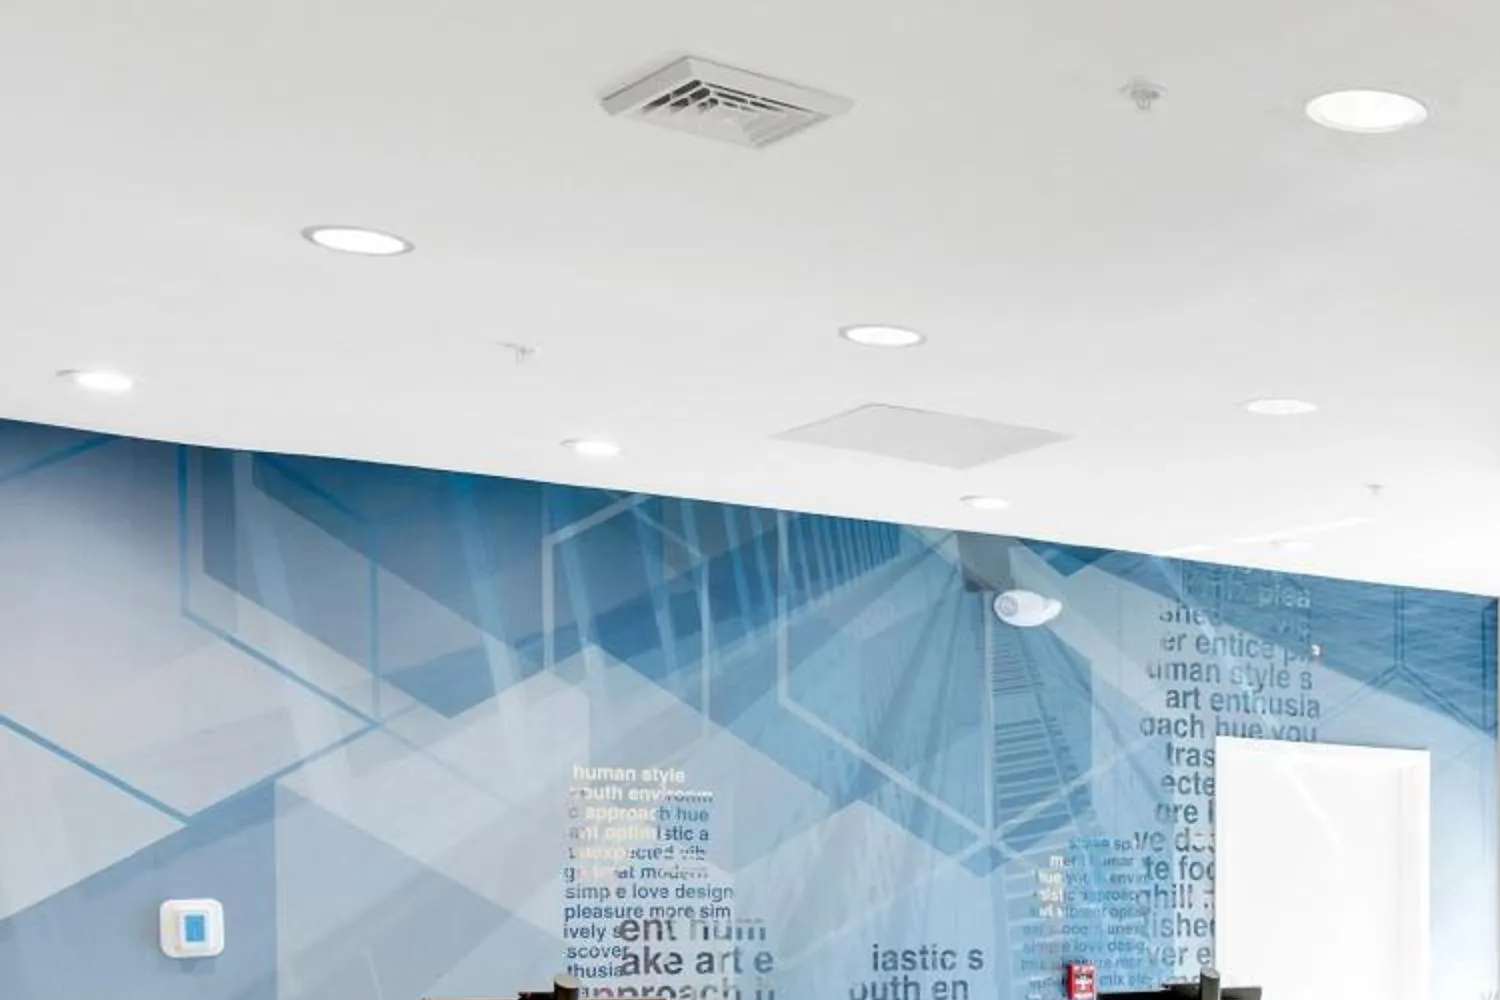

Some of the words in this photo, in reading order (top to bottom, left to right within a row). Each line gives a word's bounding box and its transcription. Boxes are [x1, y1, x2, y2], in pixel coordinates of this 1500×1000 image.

[1195, 632, 1276, 660] entice
[1229, 662, 1290, 693] style
[1299, 671, 1314, 691] s
[1164, 687, 1201, 710] art
[1209, 690, 1320, 720] enthusia
[1214, 715, 1264, 738] hue
[1164, 740, 1215, 768] tras
[572, 763, 637, 782] human
[641, 765, 686, 789] style
[676, 805, 710, 822] hue
[699, 829, 710, 842] a
[565, 883, 627, 903] simpe
[631, 883, 670, 900] love
[674, 883, 734, 904] design
[563, 903, 645, 922] pleasure
[648, 905, 696, 920] more
[699, 903, 732, 920] sim
[562, 922, 607, 942] ively
[620, 945, 684, 976] ake
[694, 946, 745, 976] art
[753, 950, 775, 976] e
[872, 942, 958, 972] iastic
[967, 948, 985, 972] s
[1196, 946, 1212, 966] e
